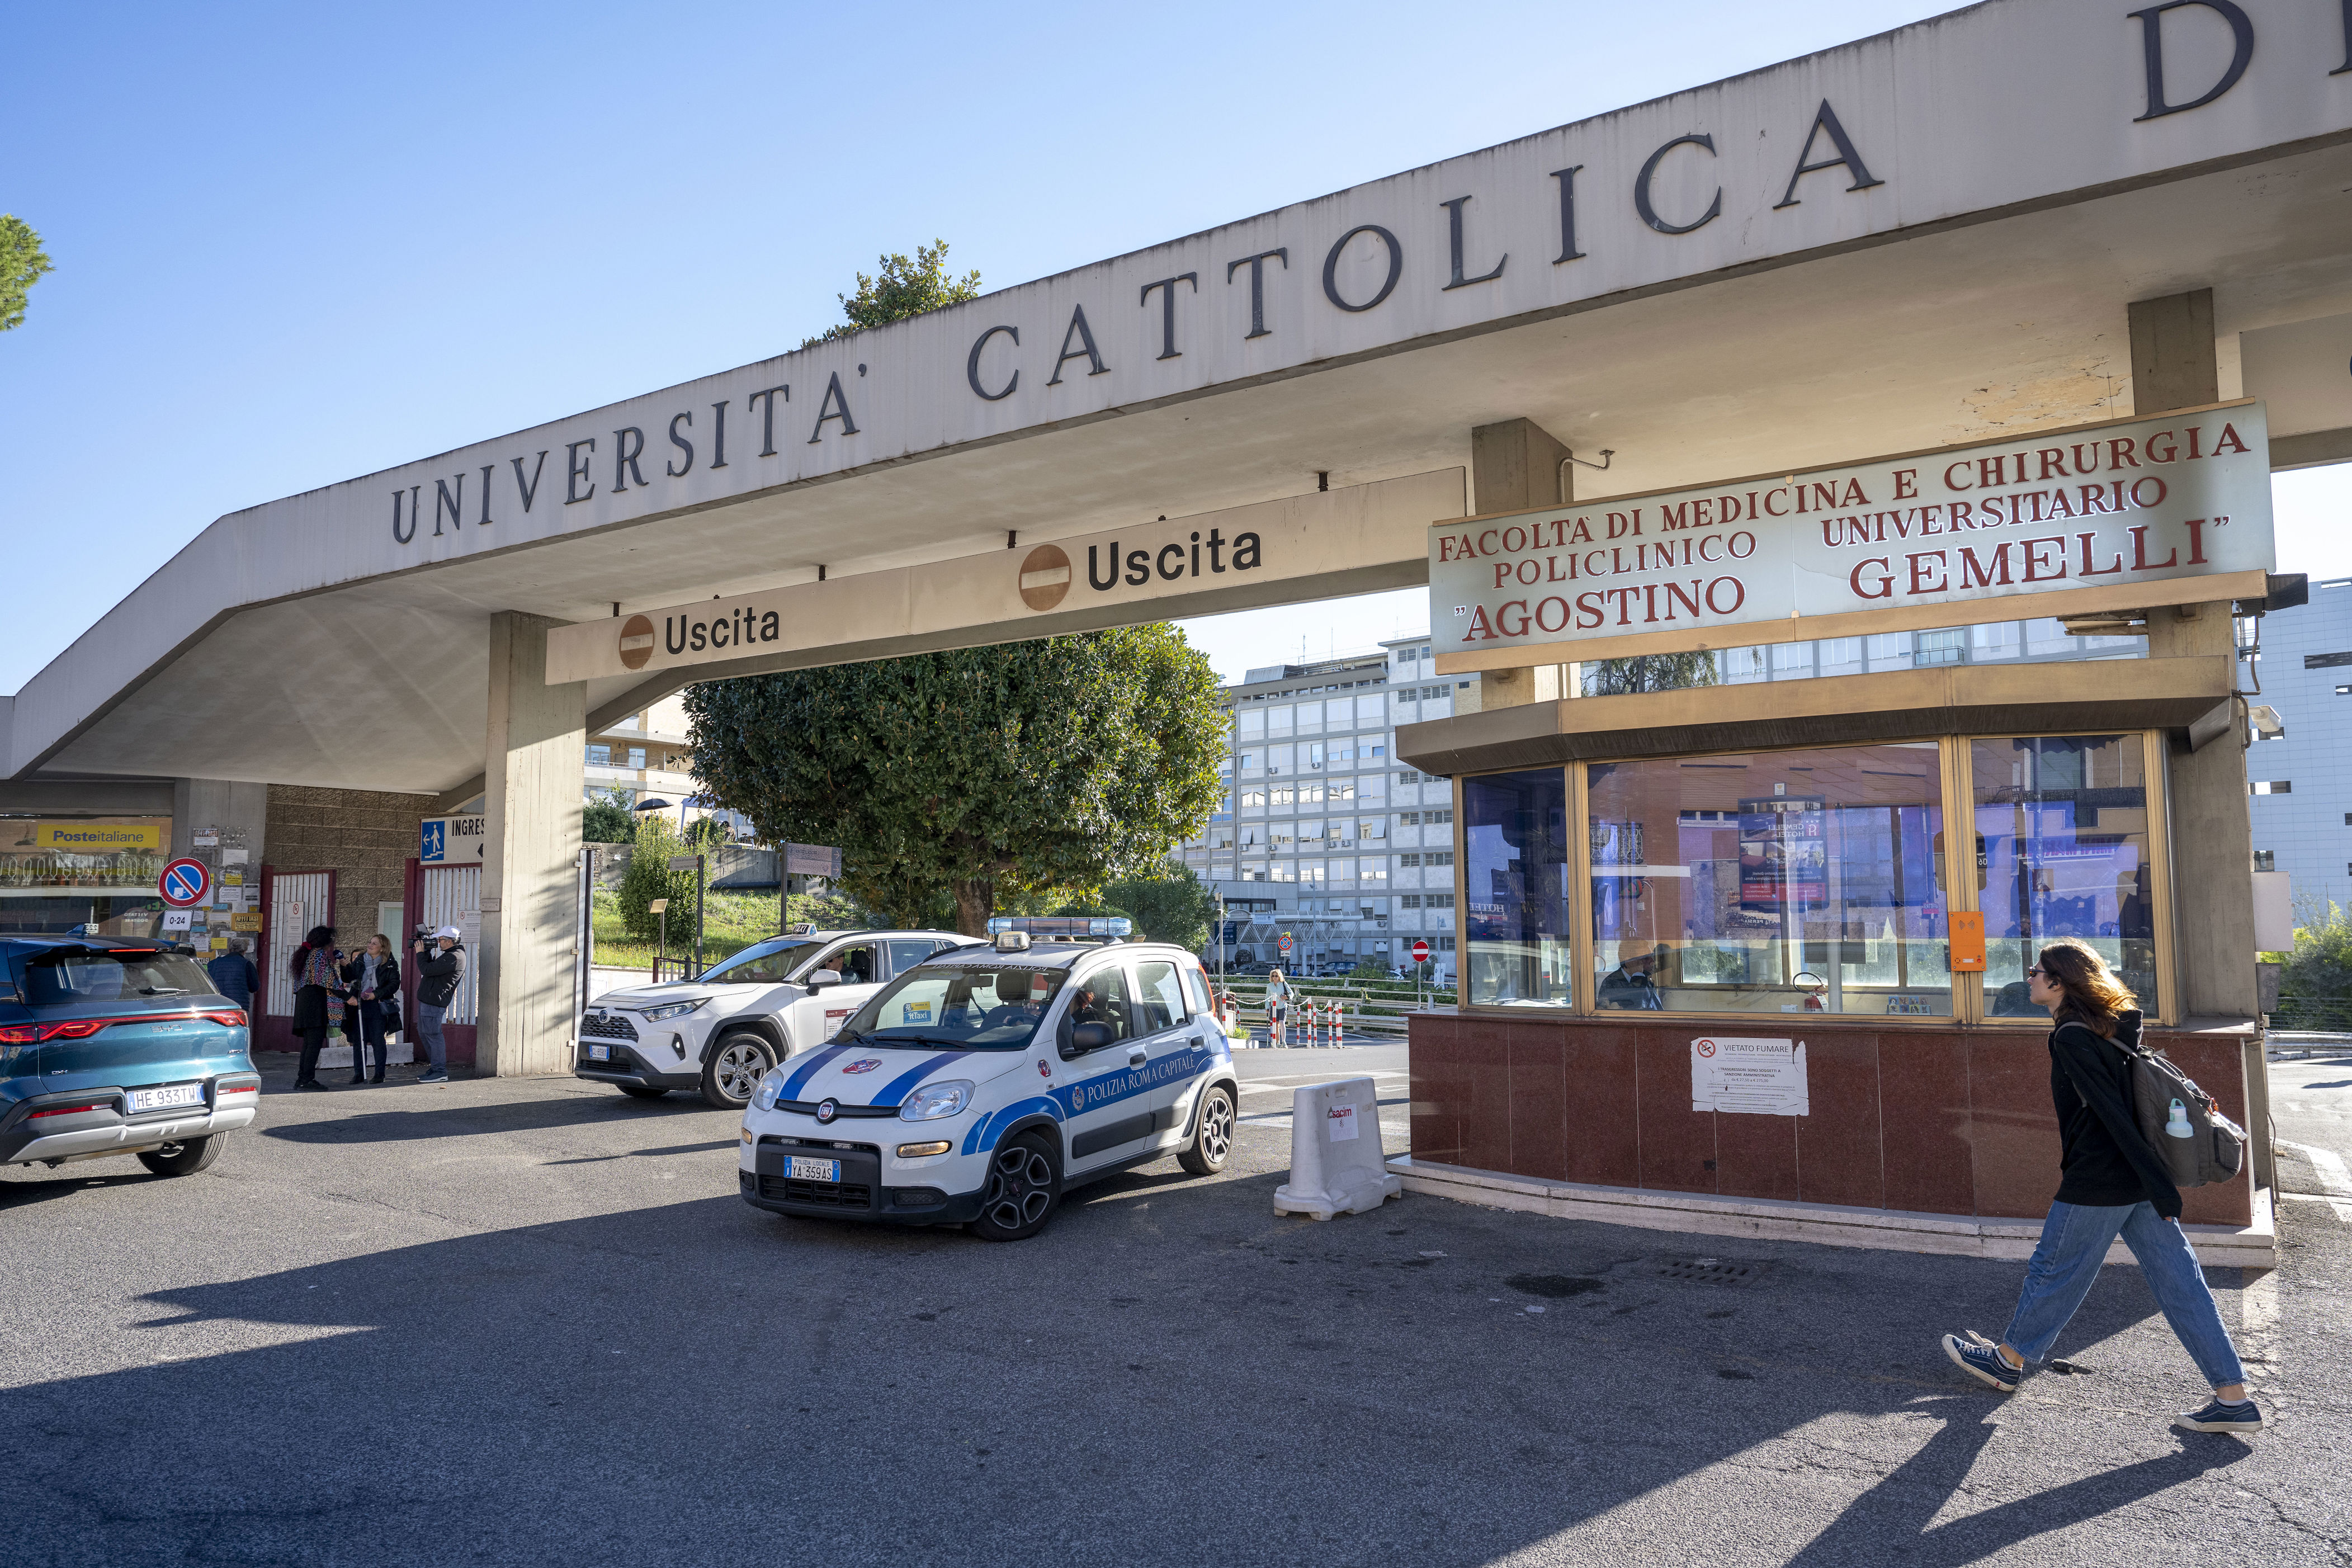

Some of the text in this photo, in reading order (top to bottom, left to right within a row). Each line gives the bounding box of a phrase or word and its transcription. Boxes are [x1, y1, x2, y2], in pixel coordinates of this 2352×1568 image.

[966, 97, 1885, 401] CATTOLICA
[2127, 0, 2352, 122] D
[1438, 422, 2251, 563] FACOLTÀ DI MEDICINA E CHIRURGIA
[1493, 476, 2167, 589] POLICLINICO UNIVERSITARIO
[1088, 528, 1263, 592] Uscita
[665, 607, 780, 655] Uscita
[53, 830, 144, 842] Posteitaliane
[169, 917, 186, 925] 0-24
[1088, 1054, 1195, 1103] POLIZIA ROMA CAPITALE
[134, 1087, 195, 1108] HE 933TW
[821, 1107, 831, 1115] FIAT
[1332, 1106, 1352, 1118] sacim
[792, 1164, 832, 1180] YA 359AS
